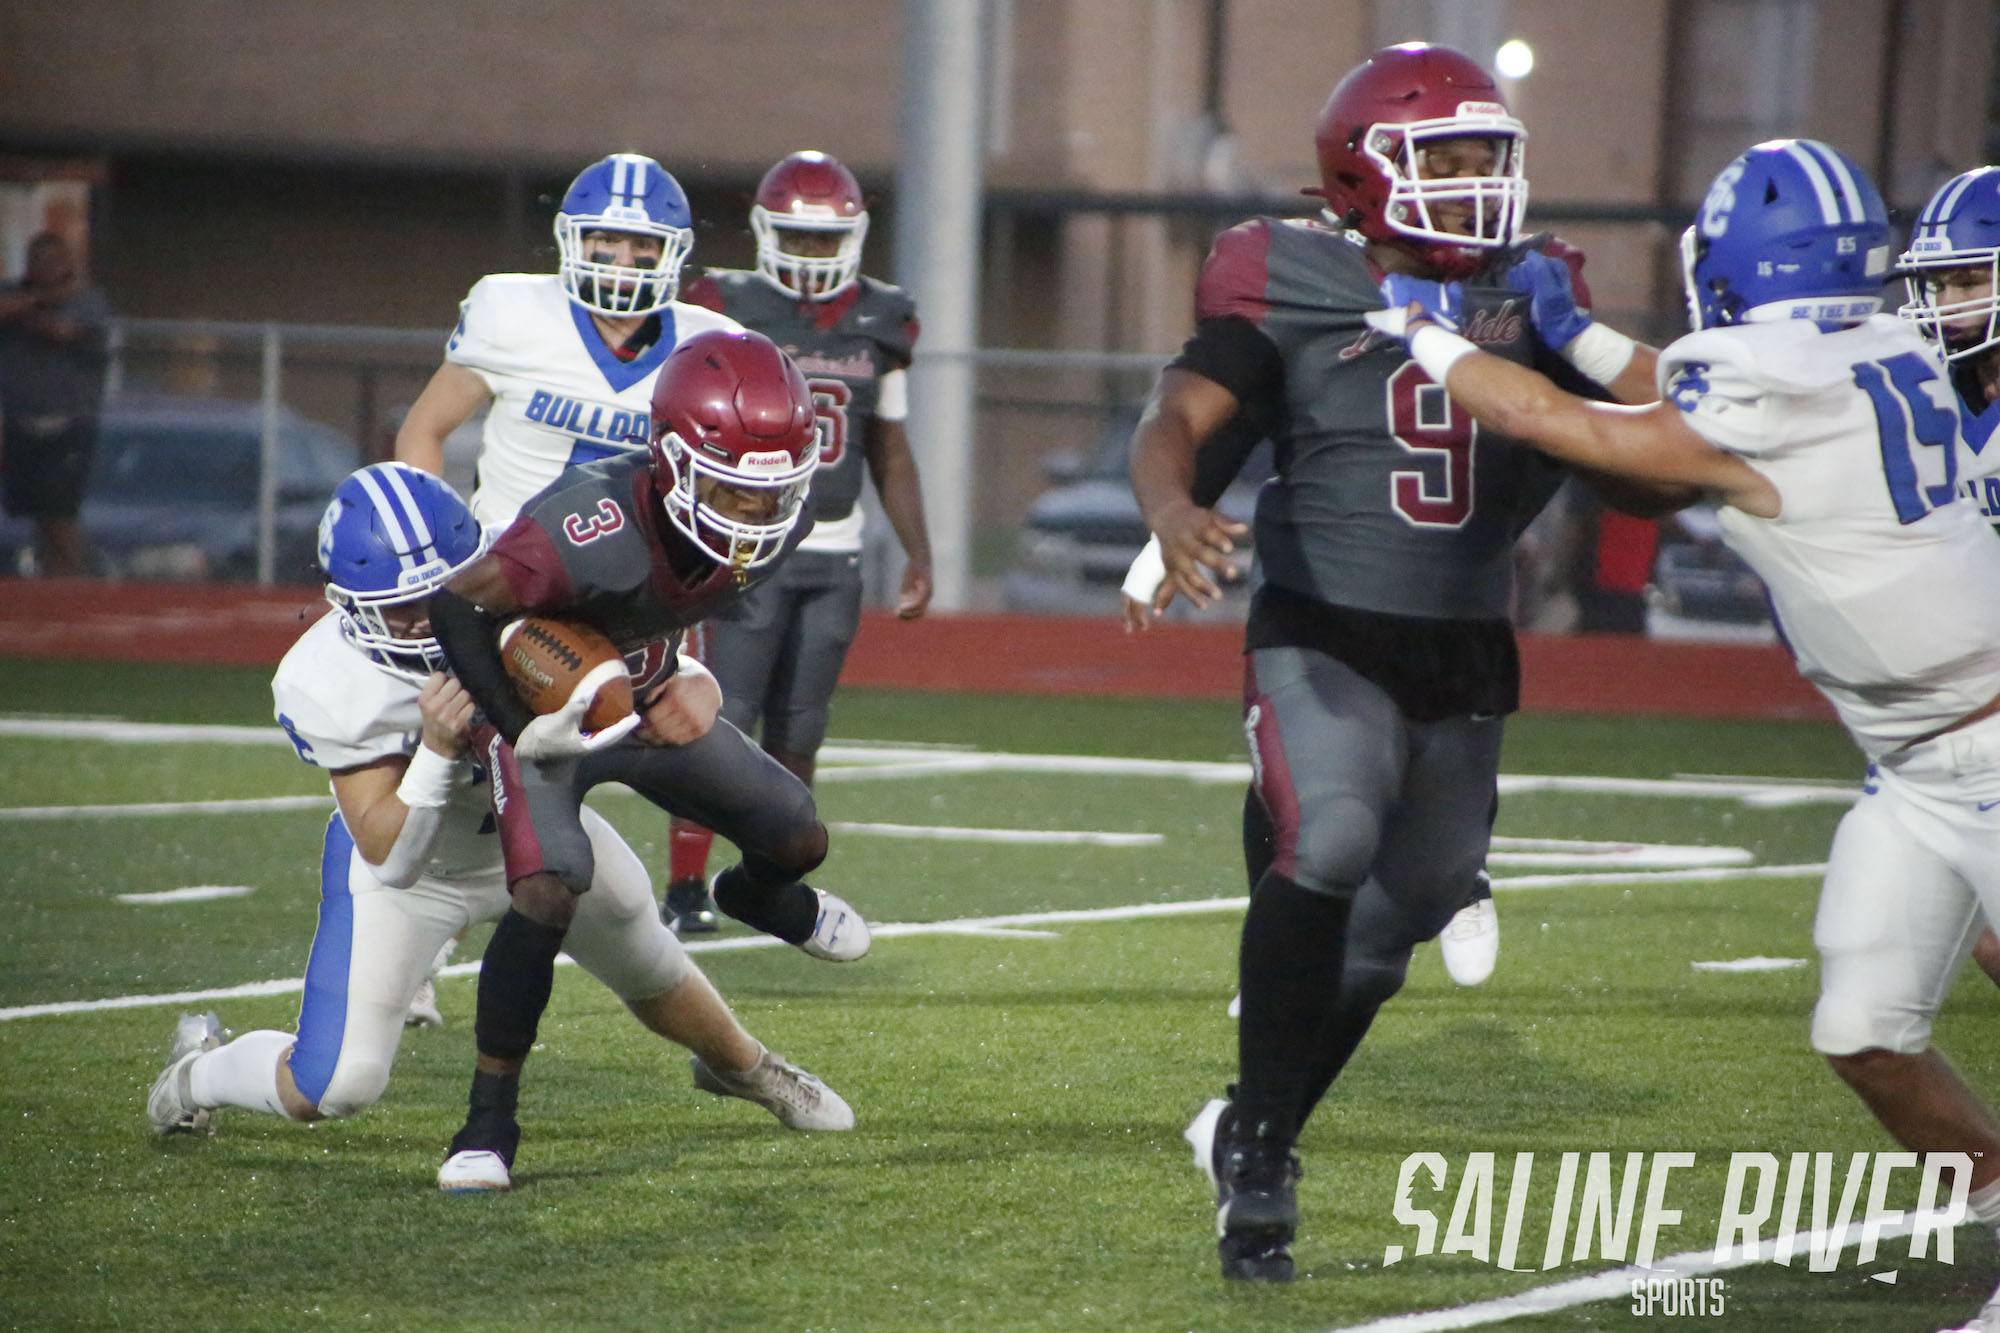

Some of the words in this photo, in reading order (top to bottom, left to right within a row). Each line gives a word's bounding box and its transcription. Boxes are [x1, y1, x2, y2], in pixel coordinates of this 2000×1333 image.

[1791, 306, 1812, 319] BE
[1818, 304, 1846, 318] THE
[524, 388, 651, 445] BULLDO
[1850, 351, 1959, 525] 15
[747, 456, 788, 466] Riddell
[1386, 358, 1478, 530] 9
[563, 497, 625, 546] 3
[407, 575, 420, 585] GO
[421, 565, 444, 581] DOGS
[512, 647, 554, 687] Wilson
